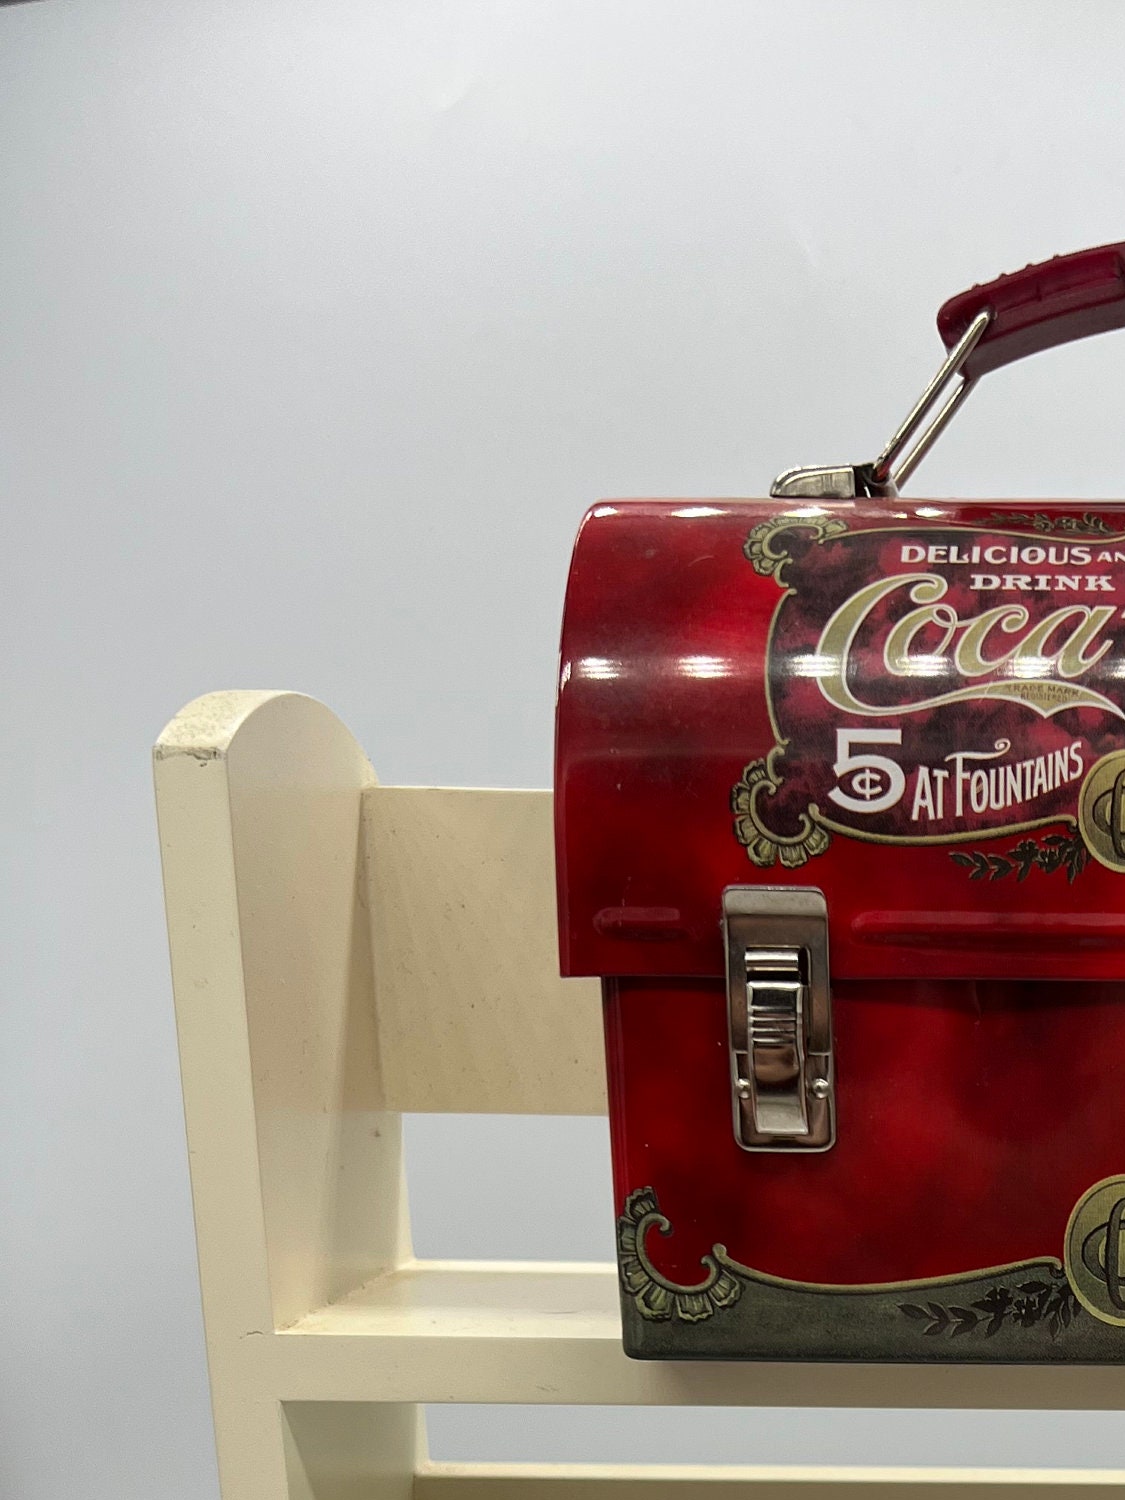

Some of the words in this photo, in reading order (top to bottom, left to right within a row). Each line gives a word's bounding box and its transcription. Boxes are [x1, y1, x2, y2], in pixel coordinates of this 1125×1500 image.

[901, 545, 1092, 565] DELICIOUS
[969, 574, 1116, 592] DRINK
[911, 765, 949, 821] AT
[944, 738, 1084, 817] FOUNTAINS
